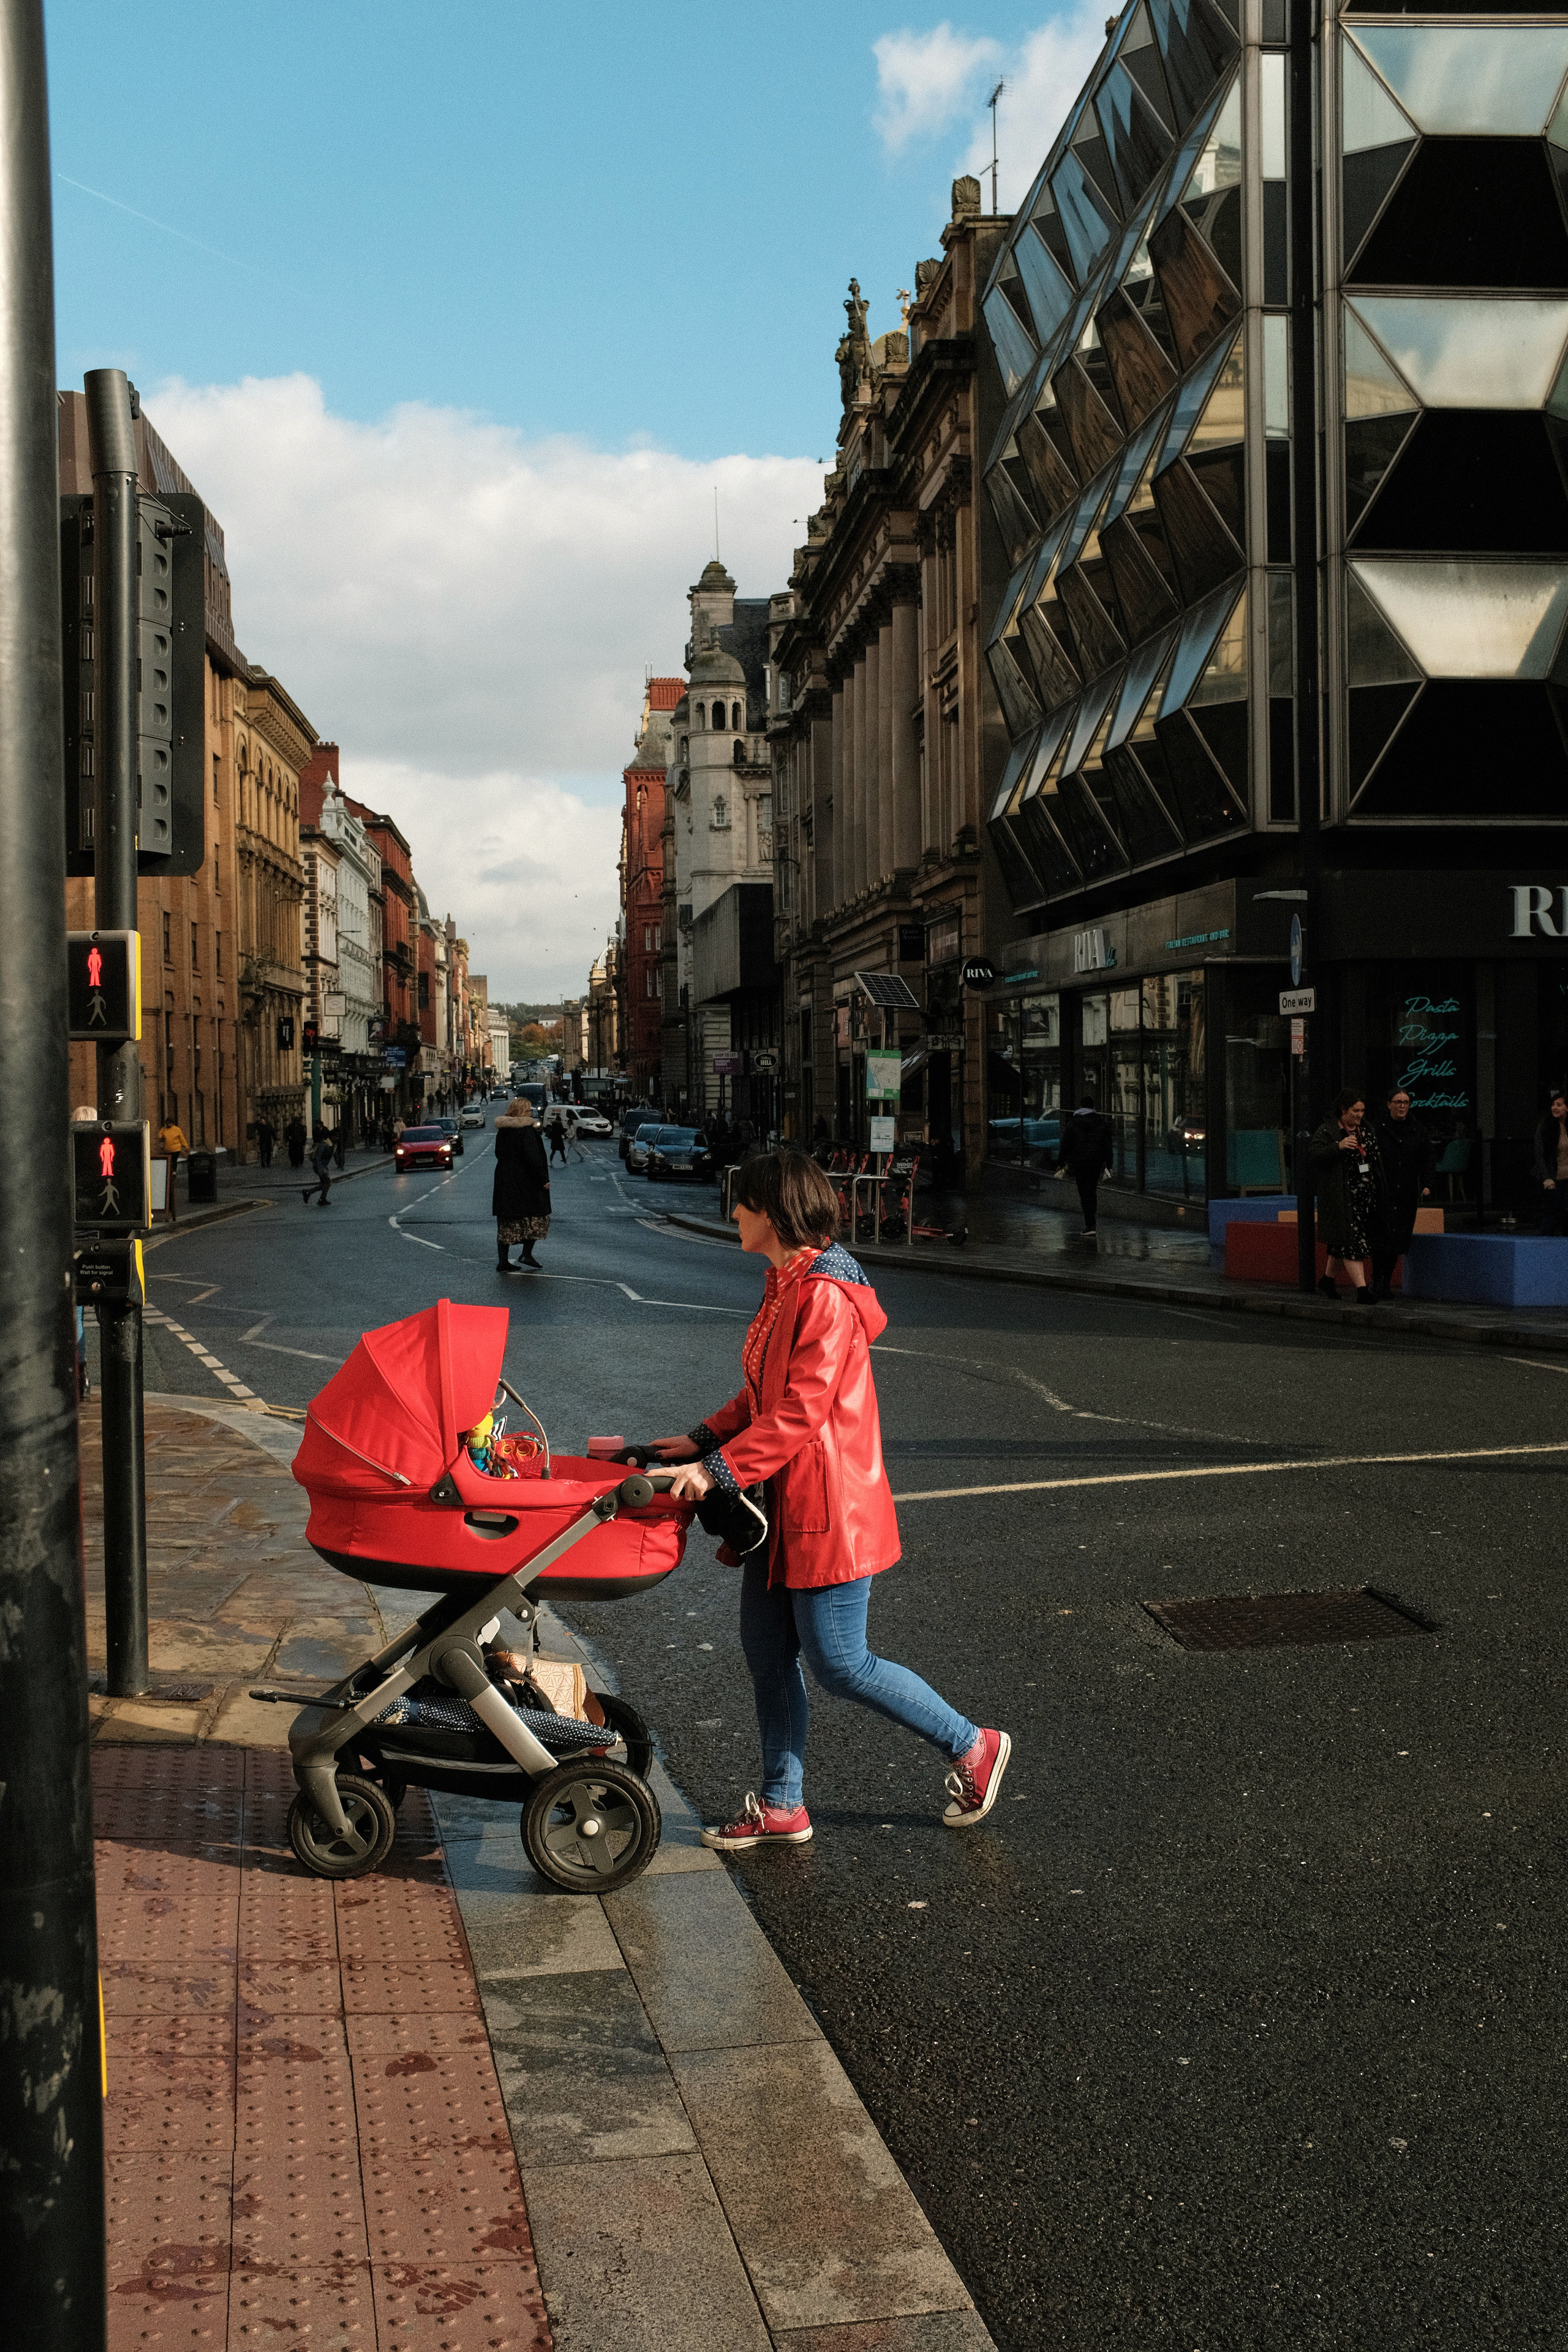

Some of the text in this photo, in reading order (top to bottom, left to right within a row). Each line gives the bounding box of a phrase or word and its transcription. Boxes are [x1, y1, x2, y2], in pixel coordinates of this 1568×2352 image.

[1074, 929, 1106, 973] RIVA
[966, 968, 993, 978] RIVA
[1282, 997, 1312, 1008] One way
[1404, 996, 1460, 1018] Pasta
[1399, 1024, 1460, 1055] Pizza
[1396, 1058, 1457, 1088] Grills
